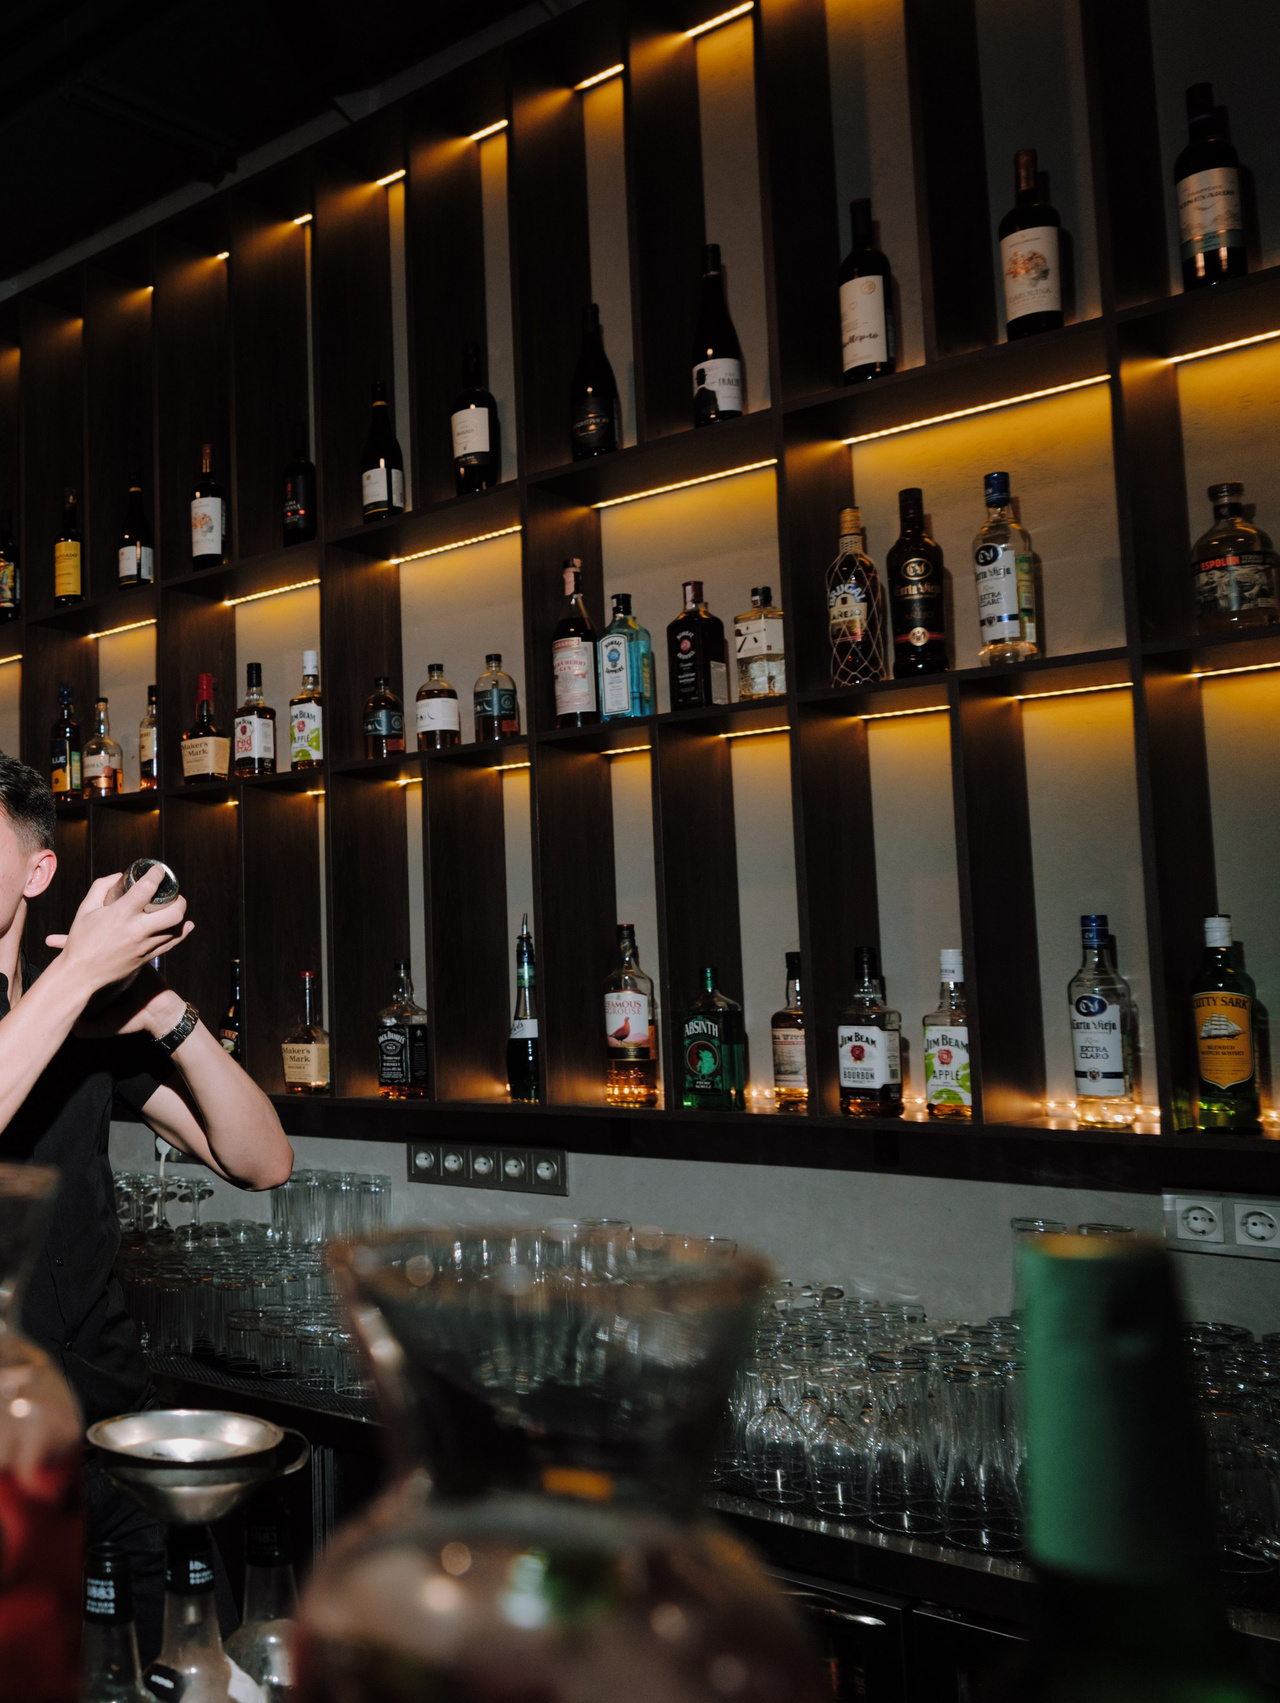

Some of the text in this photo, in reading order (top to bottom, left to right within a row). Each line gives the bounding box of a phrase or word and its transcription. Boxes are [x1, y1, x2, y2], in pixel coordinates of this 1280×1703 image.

[293, 734, 310, 743] APPLE
[181, 741, 208, 750] Maker's
[1220, 996, 1249, 1010] SARK
[684, 1020, 719, 1038] ABSINTH
[840, 1032, 877, 1049] JIM BEAM
[925, 1034, 969, 1054] JIM BEAM
[282, 1047, 311, 1055] Maker's
[1080, 1052, 1109, 1060] CLARO
[290, 1055, 310, 1063] Mark
[843, 1070, 875, 1079] BOURBON
[932, 1069, 962, 1081] APPLE
[87, 1586, 115, 1600] 1883
